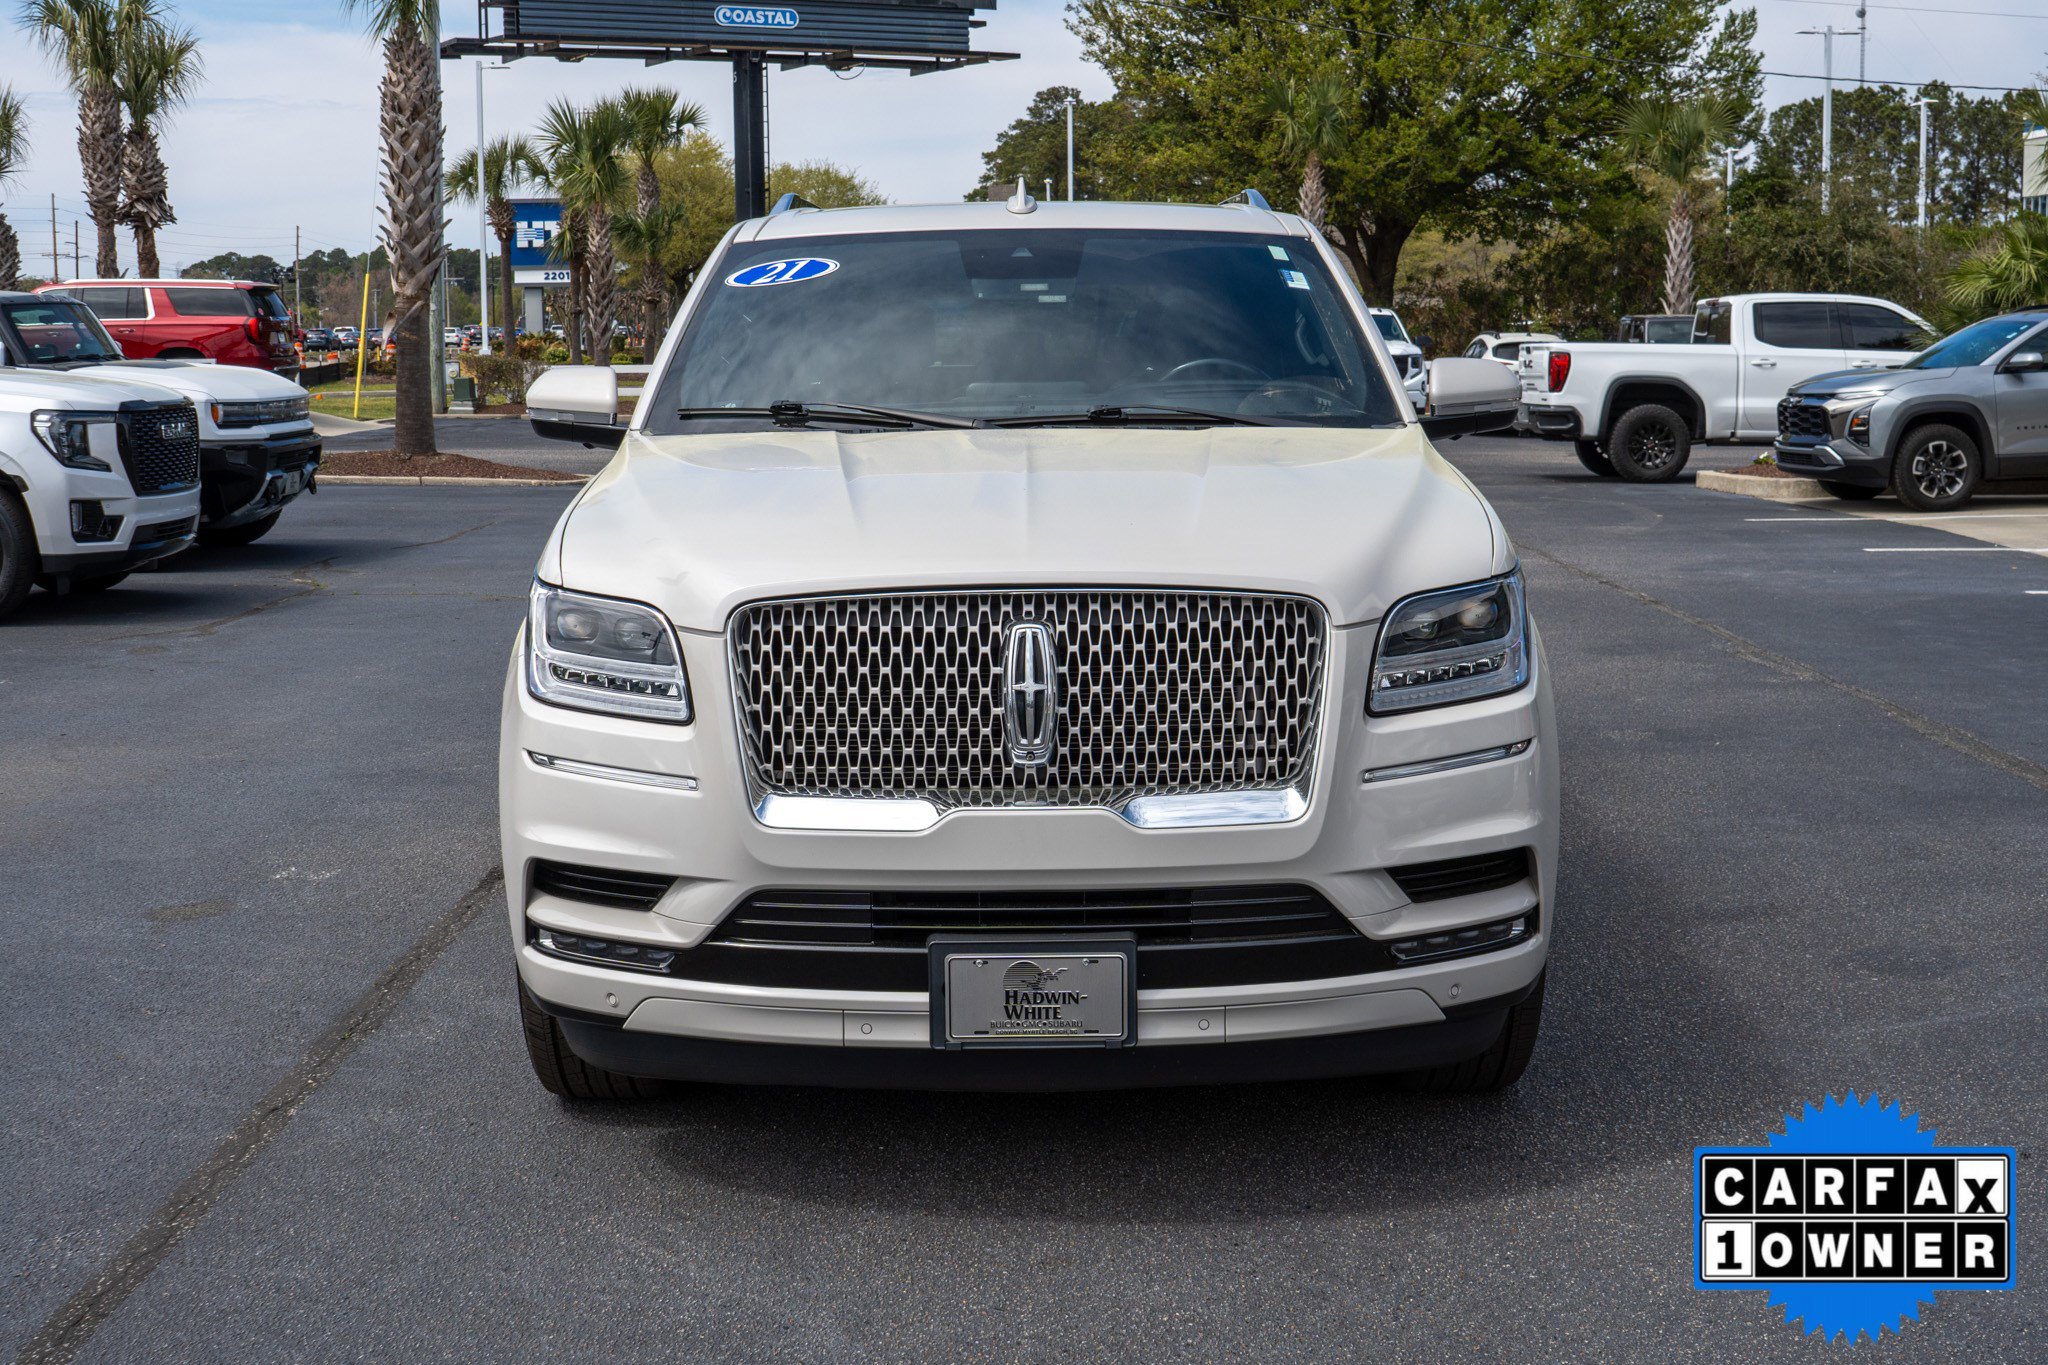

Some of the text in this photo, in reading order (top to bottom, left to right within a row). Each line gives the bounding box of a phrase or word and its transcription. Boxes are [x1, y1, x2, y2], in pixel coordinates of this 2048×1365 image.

[718, 8, 795, 25] COASTAL
[544, 272, 570, 280] 2201
[750, 260, 810, 285] 21
[1003, 1004, 1062, 1020] WHITE
[1021, 1020, 1042, 1028] GMC
[1048, 1020, 1083, 1028] SUBARU
